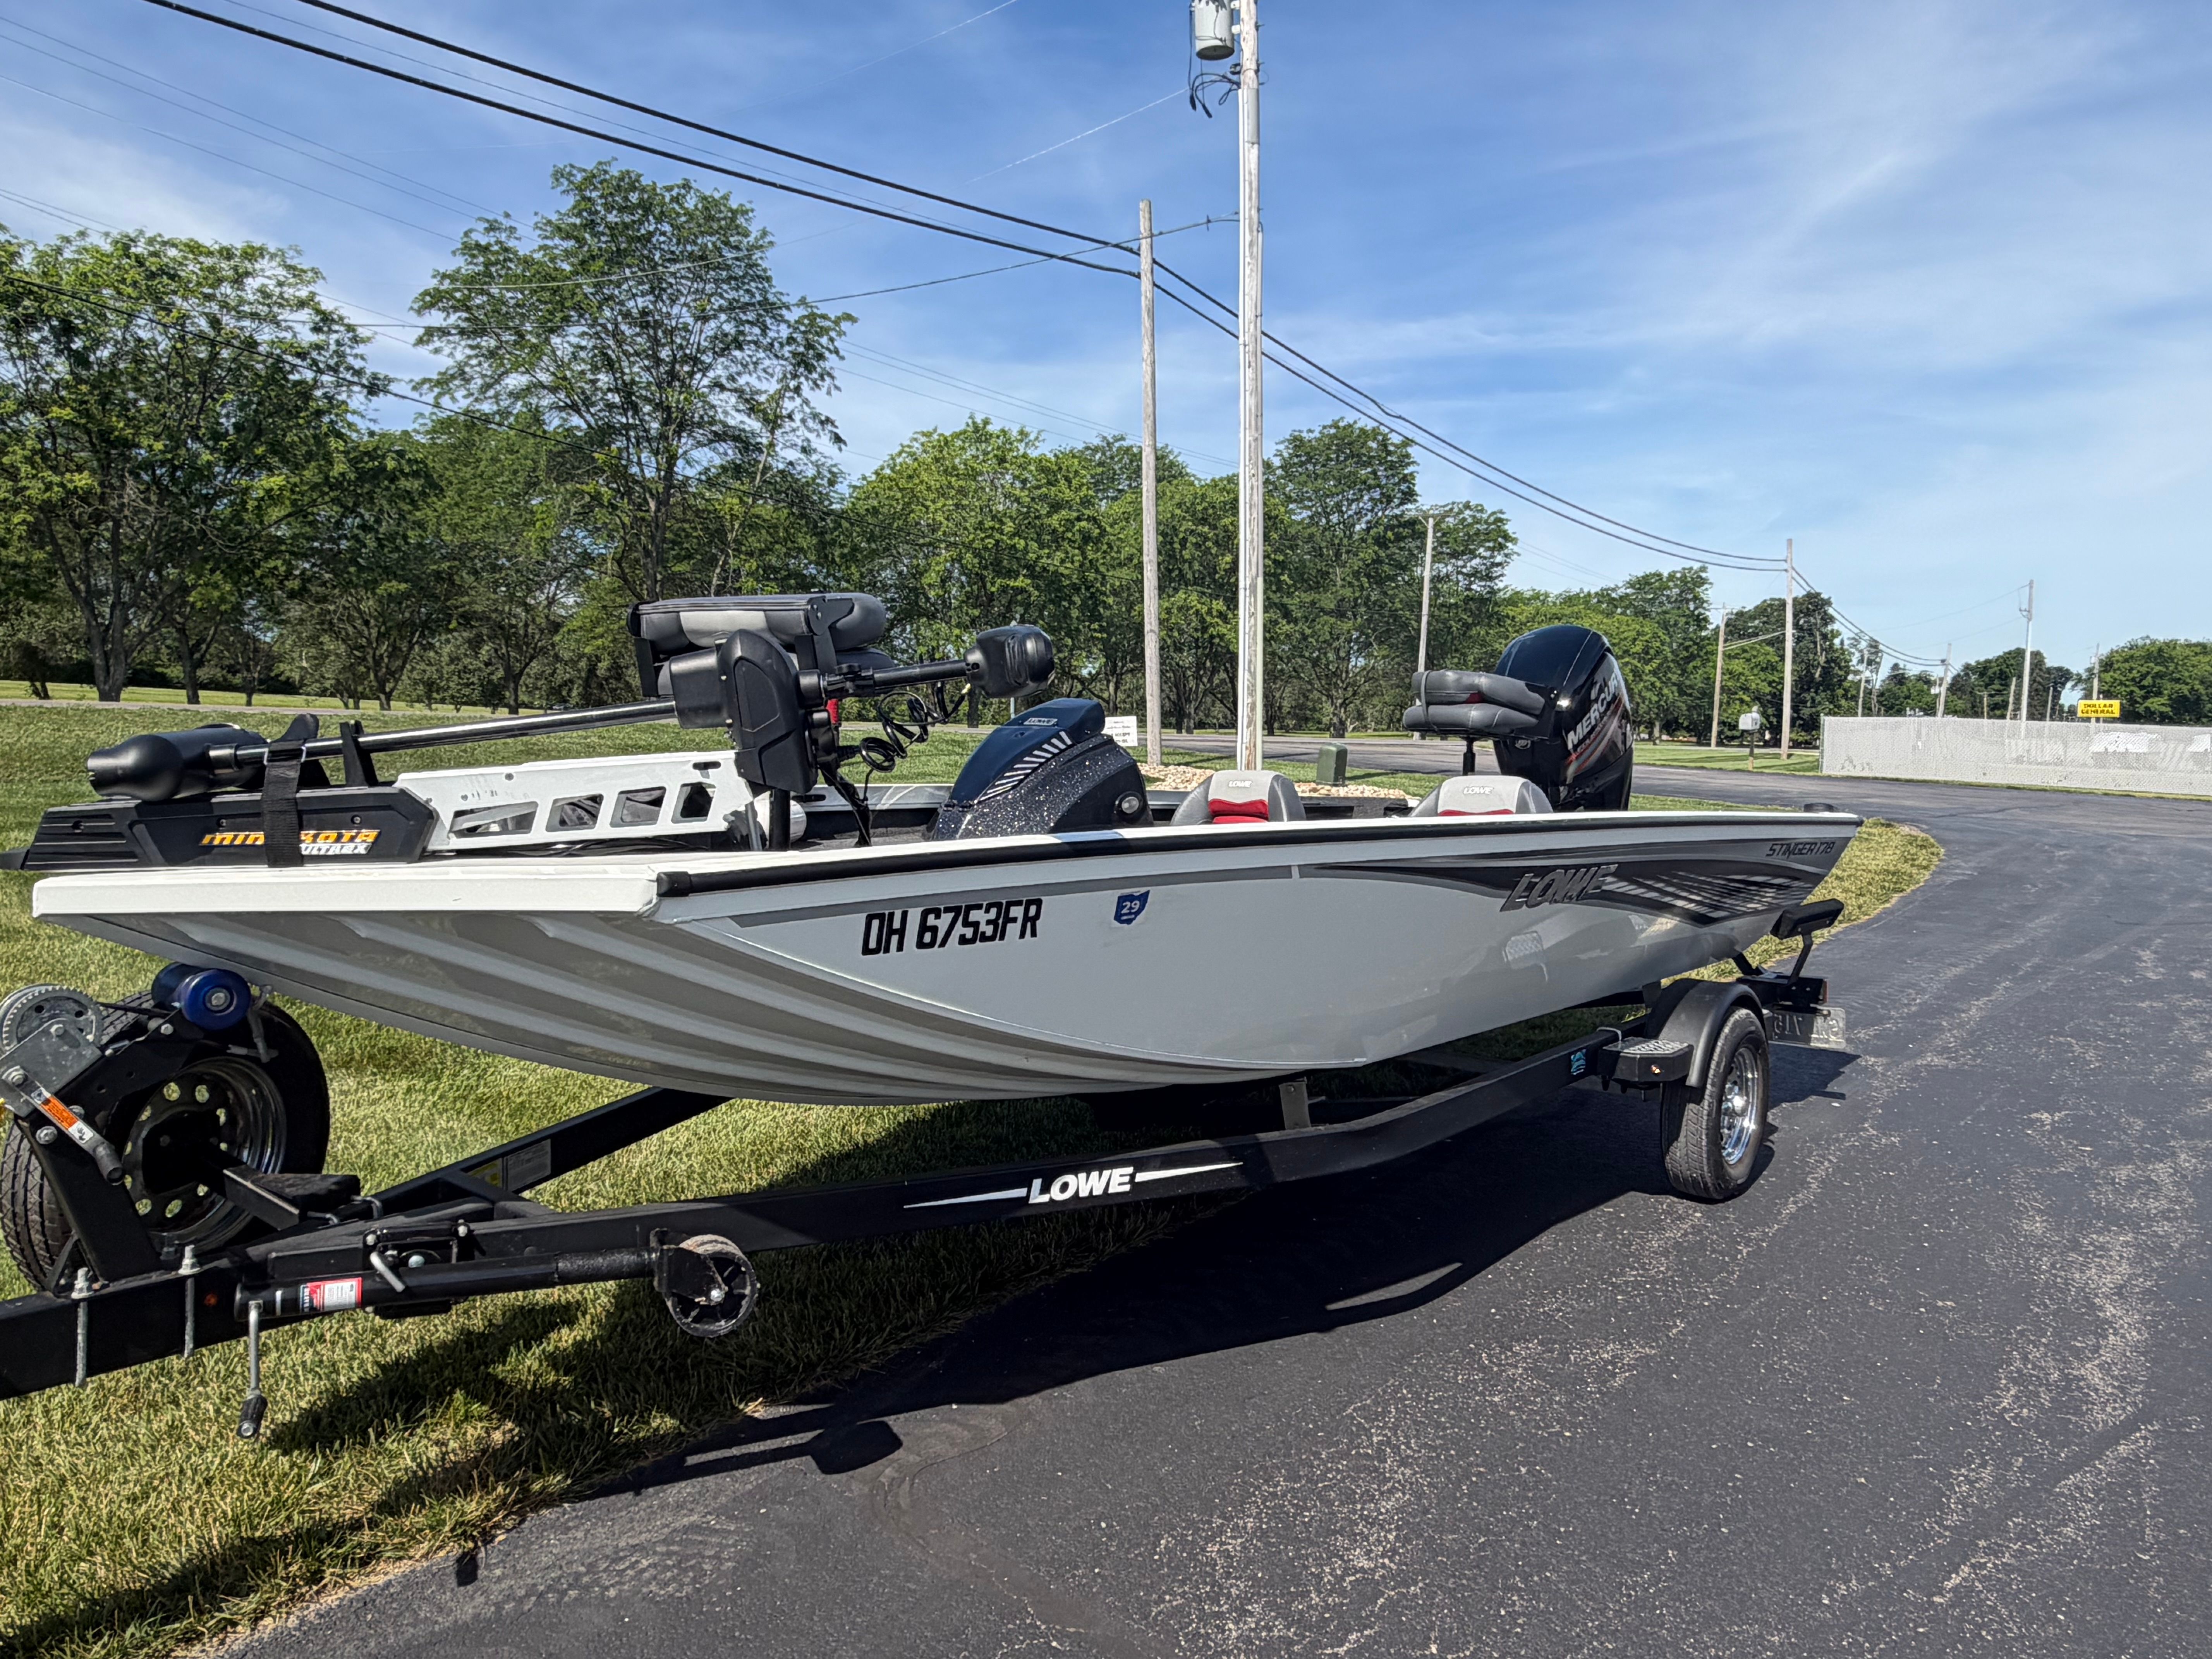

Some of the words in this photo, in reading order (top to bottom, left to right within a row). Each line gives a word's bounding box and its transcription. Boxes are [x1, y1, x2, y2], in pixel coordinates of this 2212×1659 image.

[1567, 672, 1618, 750] MERCUR
[1765, 842, 1817, 859] STINGER
[1815, 841, 1836, 855] 178
[1121, 900, 1140, 914] 29
[1499, 864, 1618, 912] LOWE
[862, 910, 908, 956] OH
[915, 898, 1043, 950] 6753FR
[1029, 1167, 1133, 1204] LOWE
